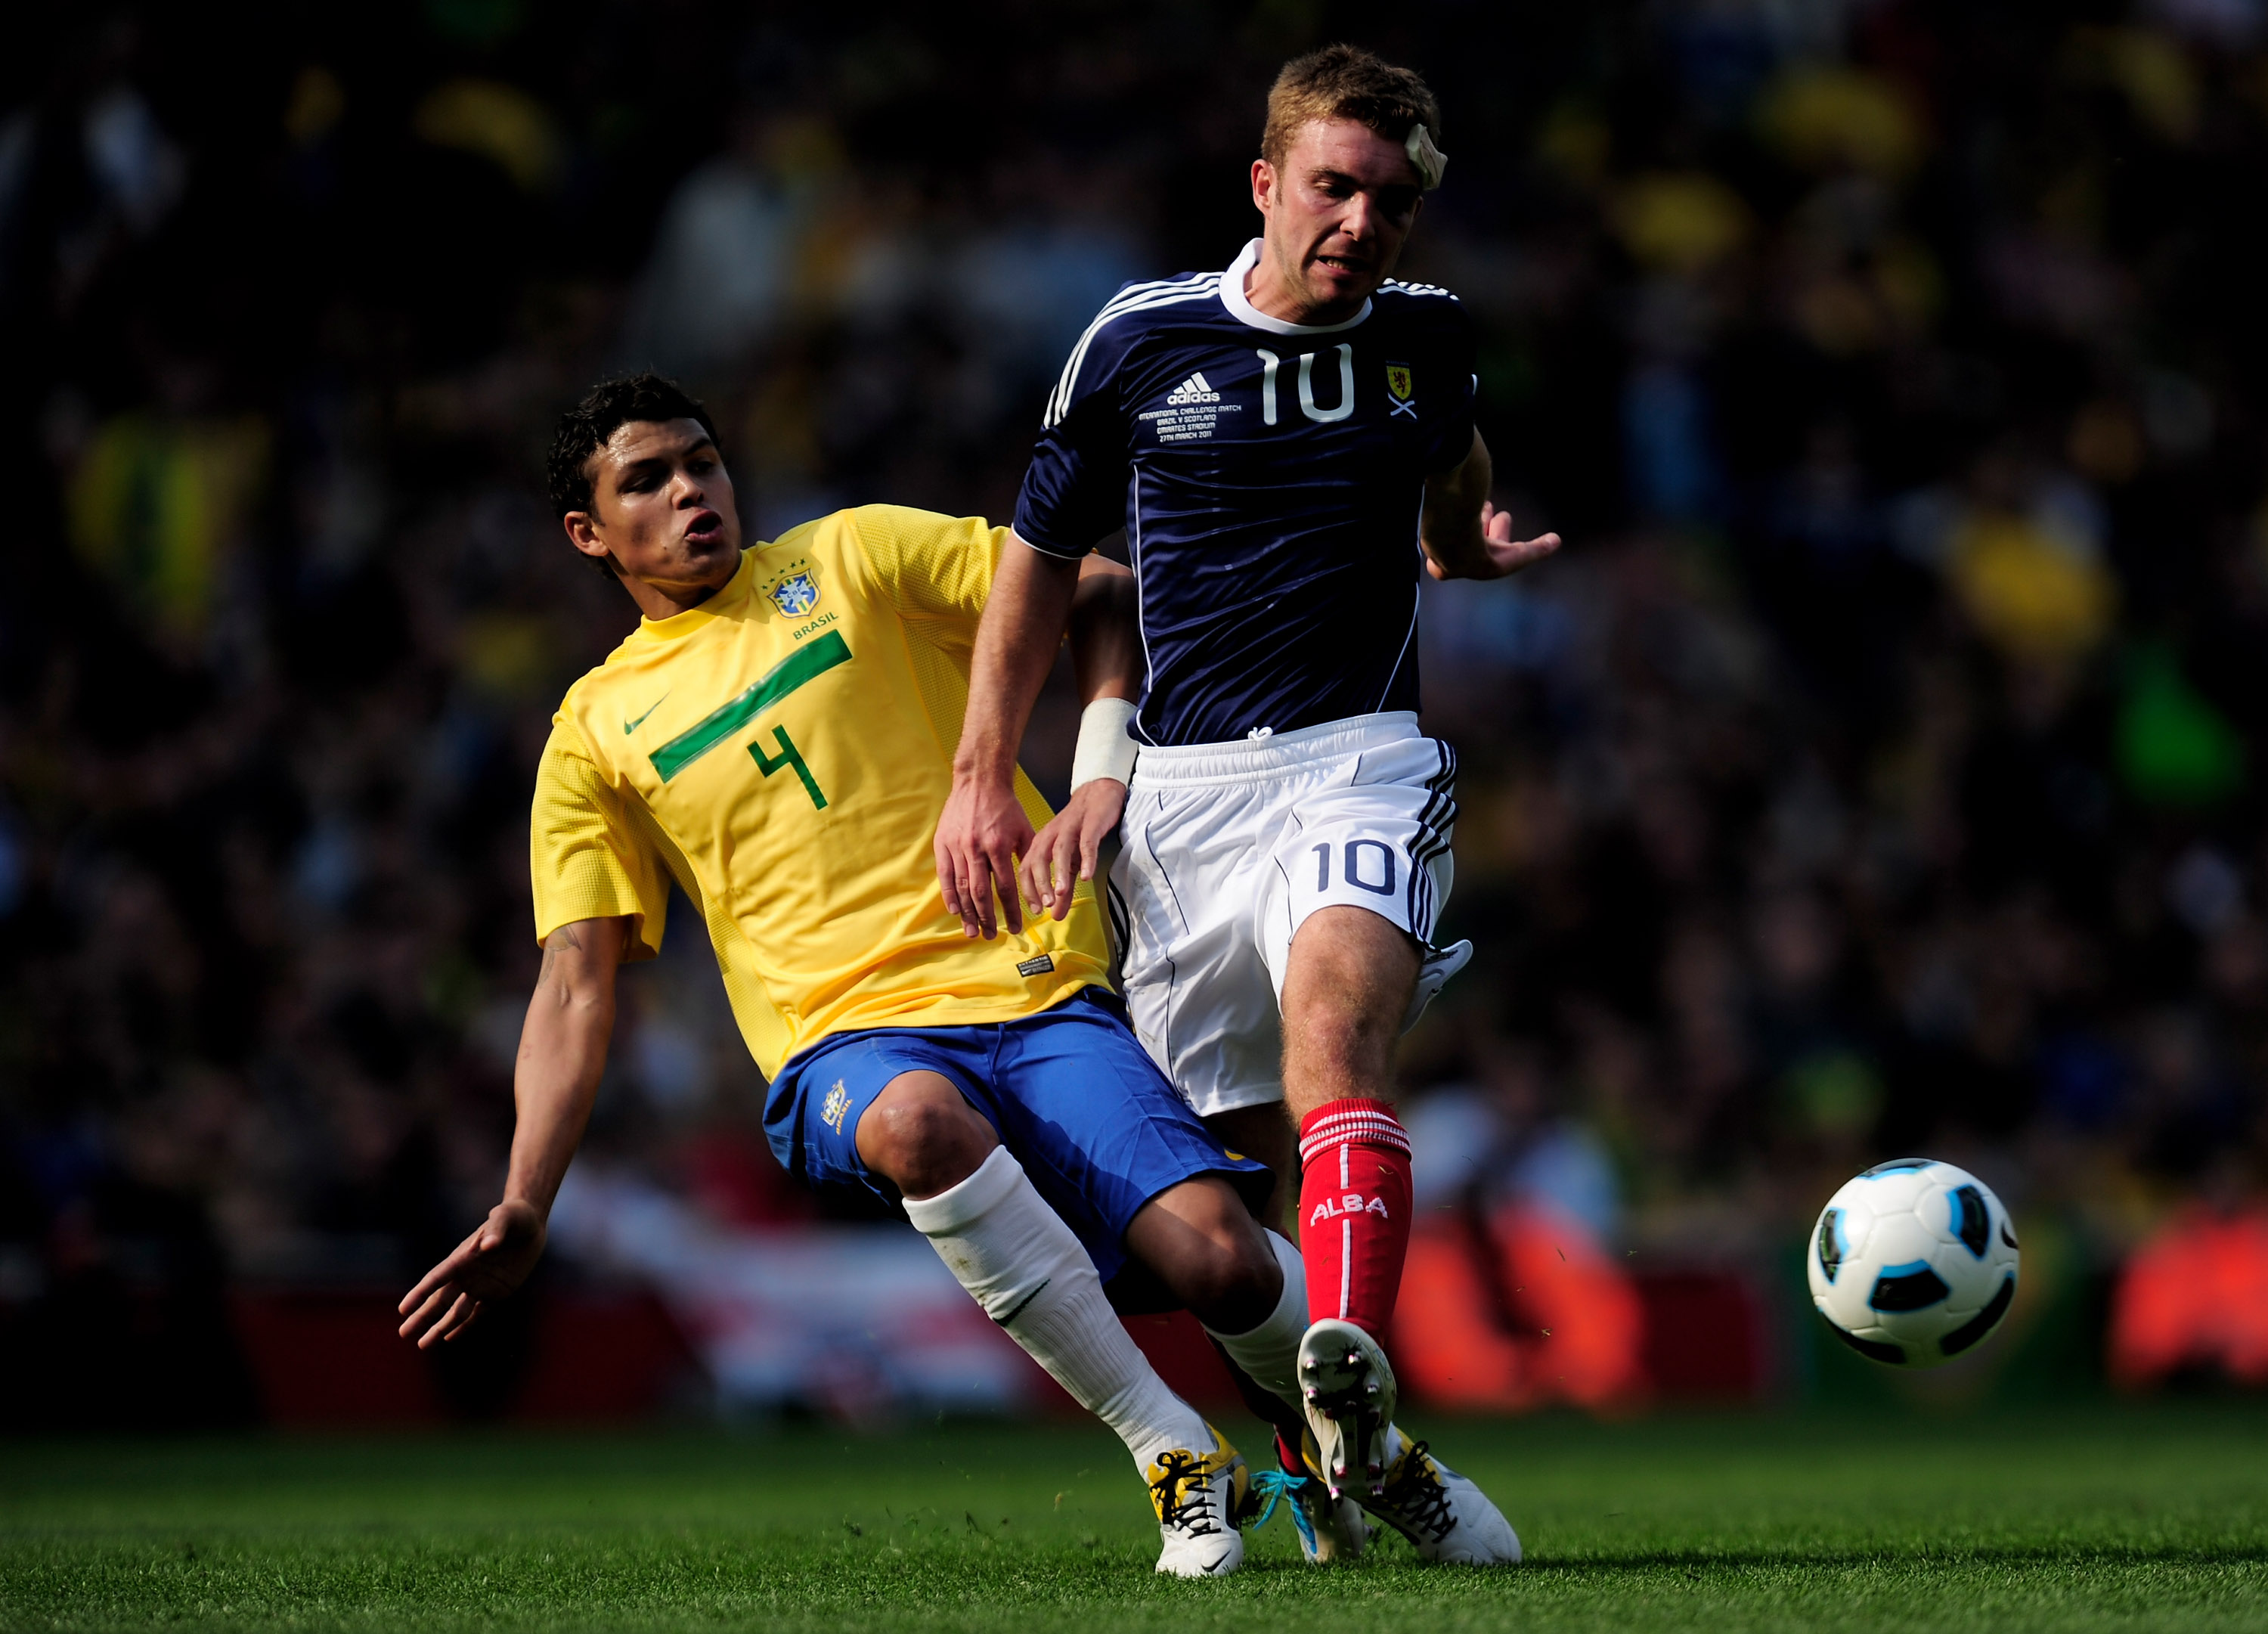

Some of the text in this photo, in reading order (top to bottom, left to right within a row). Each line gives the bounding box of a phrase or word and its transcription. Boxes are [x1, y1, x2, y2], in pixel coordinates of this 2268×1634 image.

[1256, 343, 1354, 426] 10
[1167, 390, 1220, 405] adidas
[1157, 417, 1176, 426] BRAZIL
[1184, 414, 1216, 423] SCOTLAND
[1180, 406, 1217, 415] CHALLENGE
[1175, 432, 1198, 440] MARCH
[1187, 423, 1216, 431] STADIUM
[793, 612, 838, 640] BRASIL
[747, 724, 828, 811] 4
[1312, 839, 1396, 896] 10
[1310, 1193, 1388, 1227] ALBA
